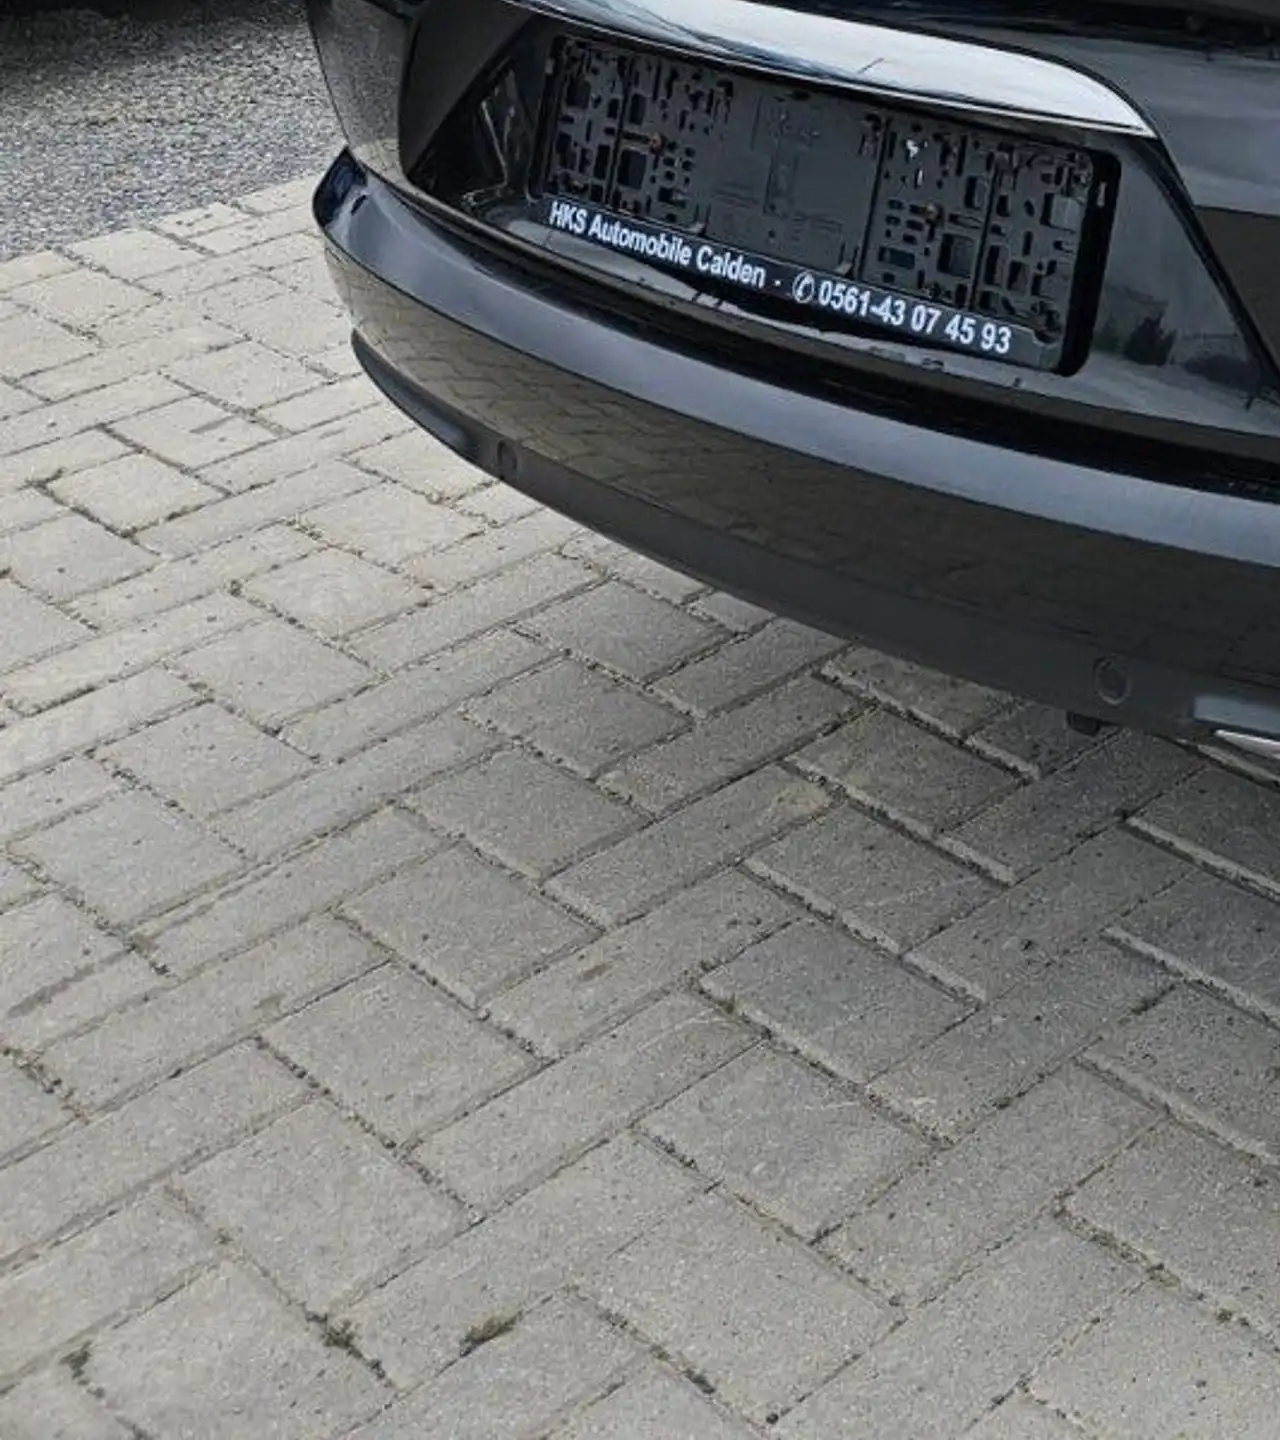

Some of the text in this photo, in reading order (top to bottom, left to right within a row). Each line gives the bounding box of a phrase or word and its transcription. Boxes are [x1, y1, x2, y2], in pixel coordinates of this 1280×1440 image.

[549, 200, 1012, 354] HKS Automobile Calden 0561-43 07 45 93
